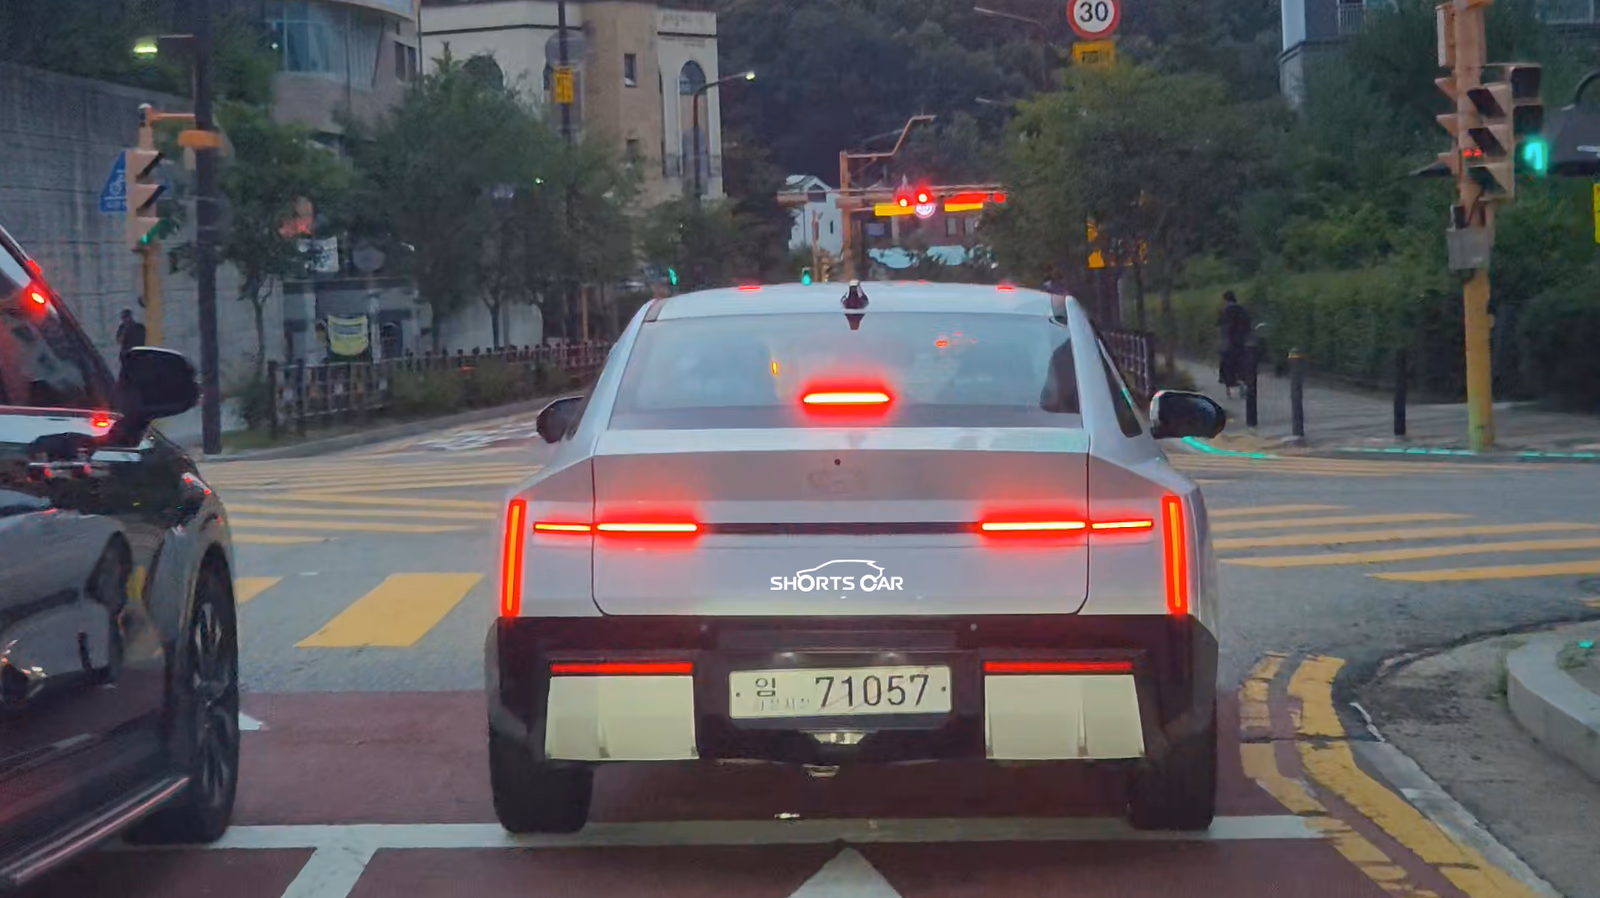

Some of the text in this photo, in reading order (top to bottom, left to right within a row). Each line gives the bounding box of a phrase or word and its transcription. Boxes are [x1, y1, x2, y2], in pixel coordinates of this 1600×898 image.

[1080, 2, 1109, 22] 30
[755, 677, 776, 698] 임
[815, 674, 930, 709] 71057
